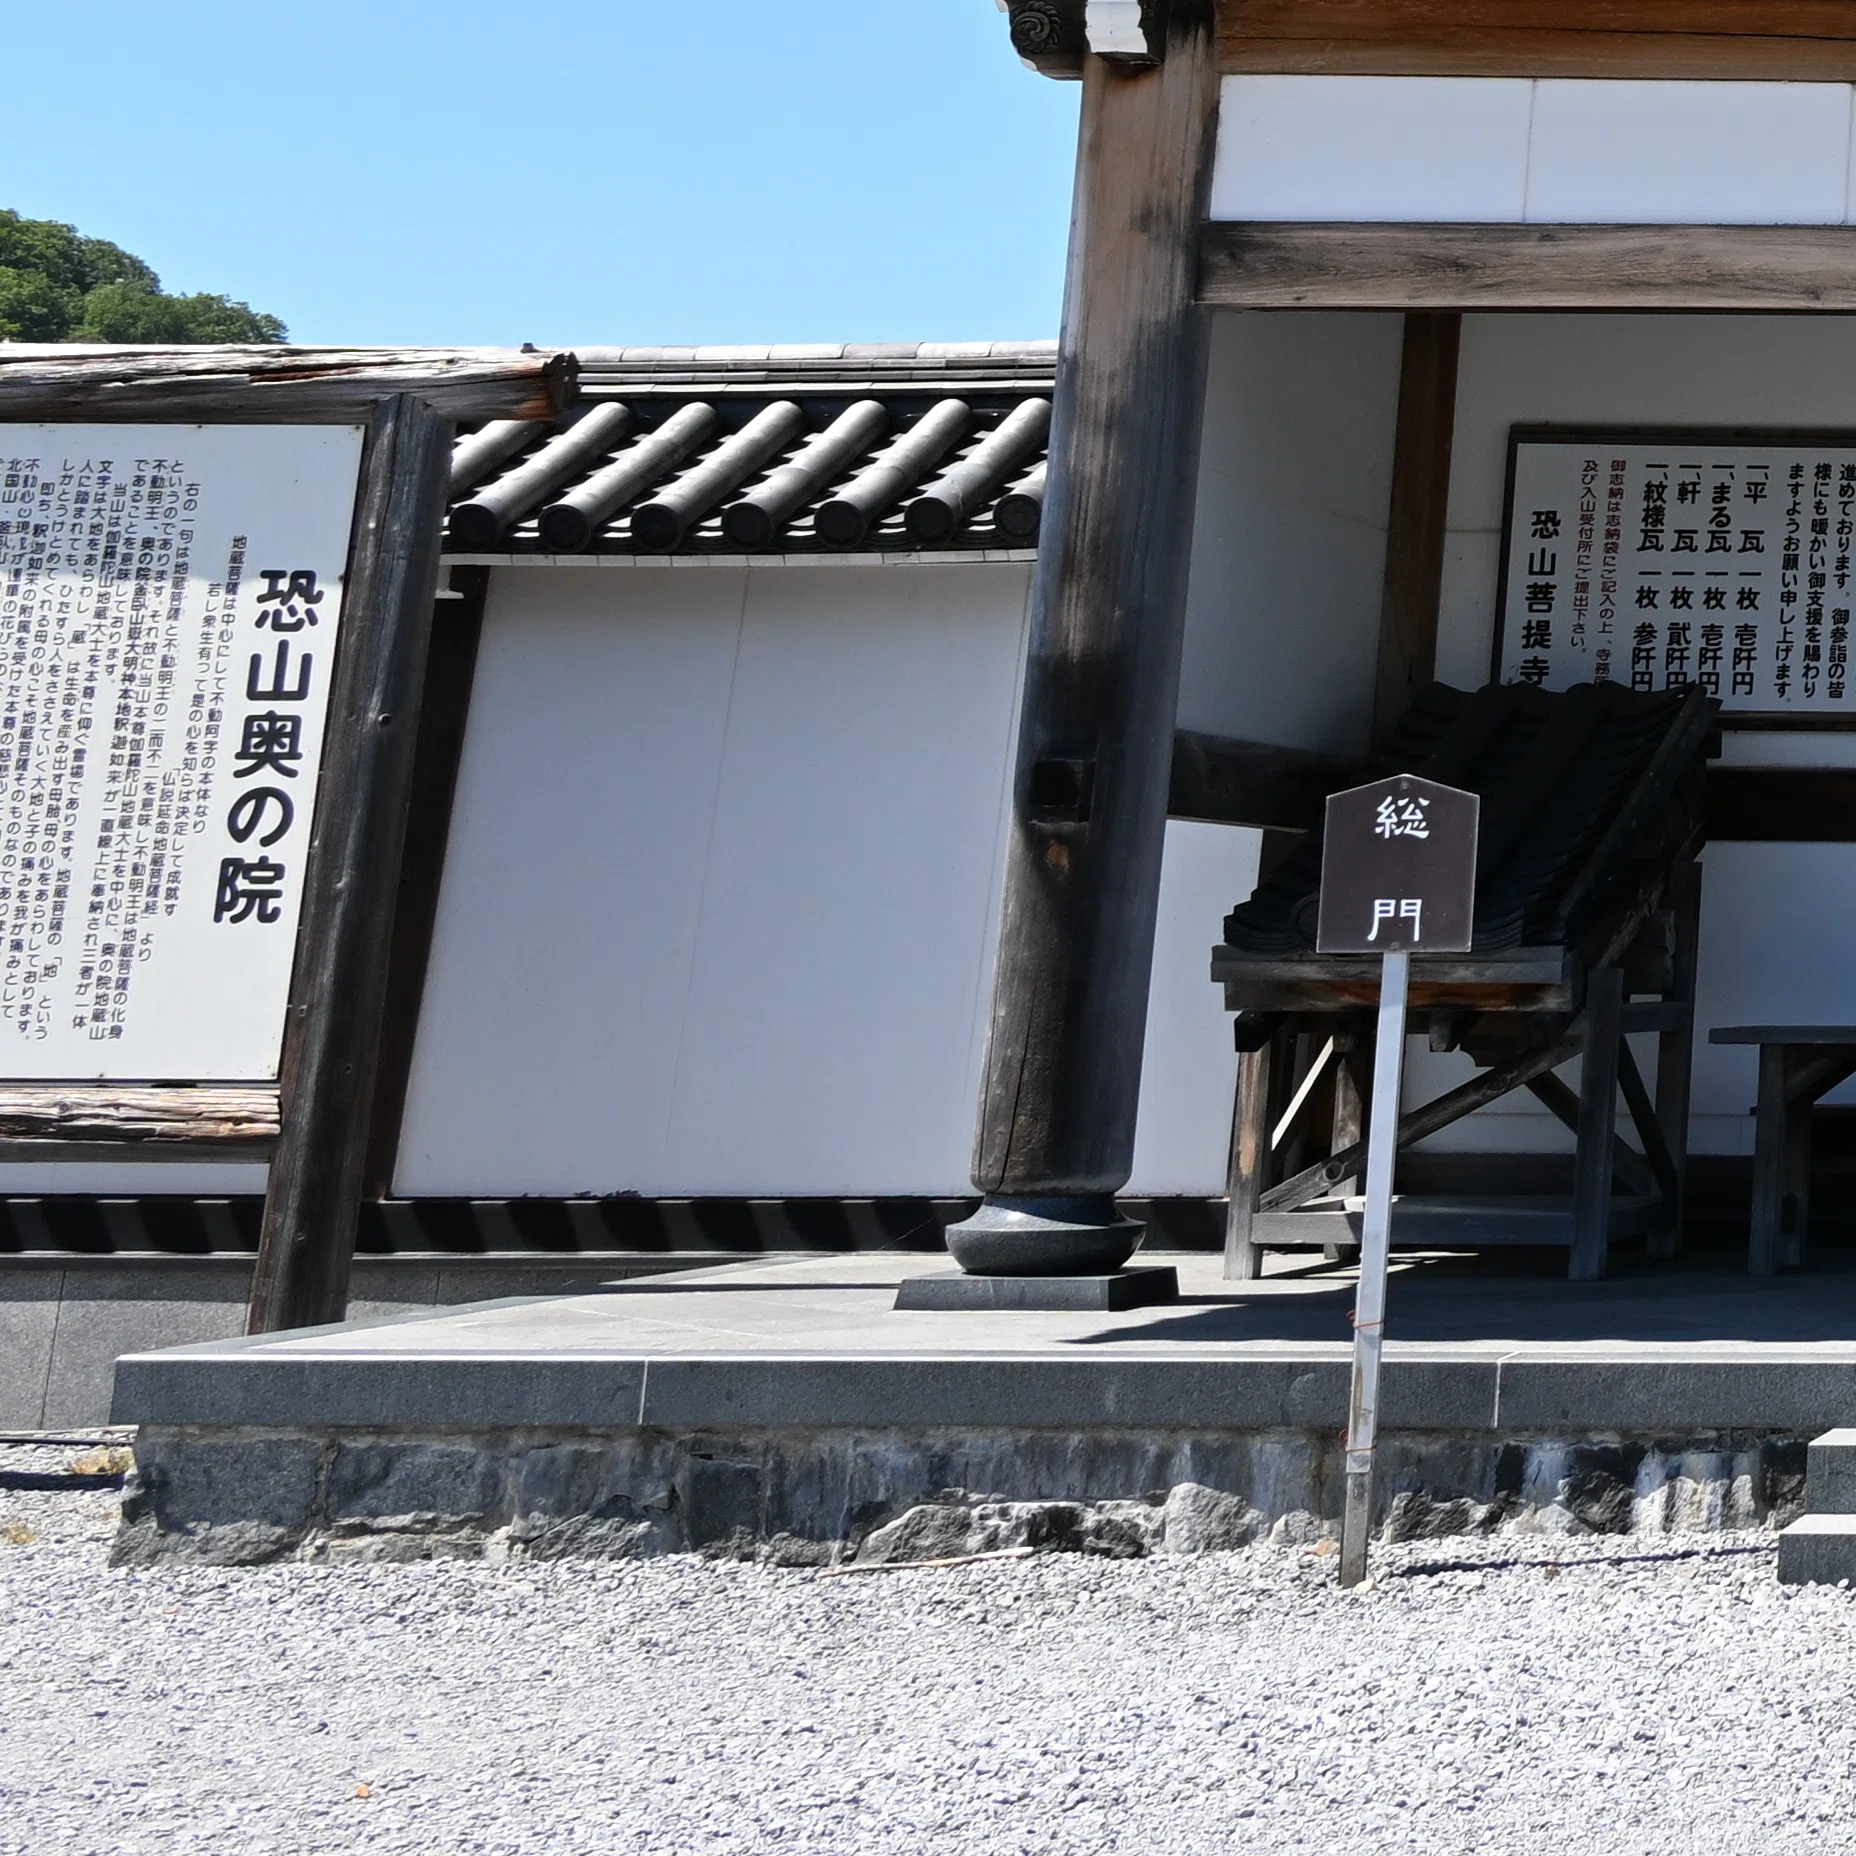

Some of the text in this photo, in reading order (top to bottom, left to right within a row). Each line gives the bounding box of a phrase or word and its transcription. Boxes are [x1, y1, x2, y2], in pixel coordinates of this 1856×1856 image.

[1520, 511, 1561, 685] 恐山菩提寺
[1571, 460, 1599, 653] 及び入山受付所にご提出下さい。
[1774, 464, 1804, 702] ますようお願い申し上げます。
[1802, 463, 1832, 698] 様にも暖かい御支援を賜わり
[212, 570, 326, 924] 恐山奥の院
[1367, 795, 1430, 942] 総門
